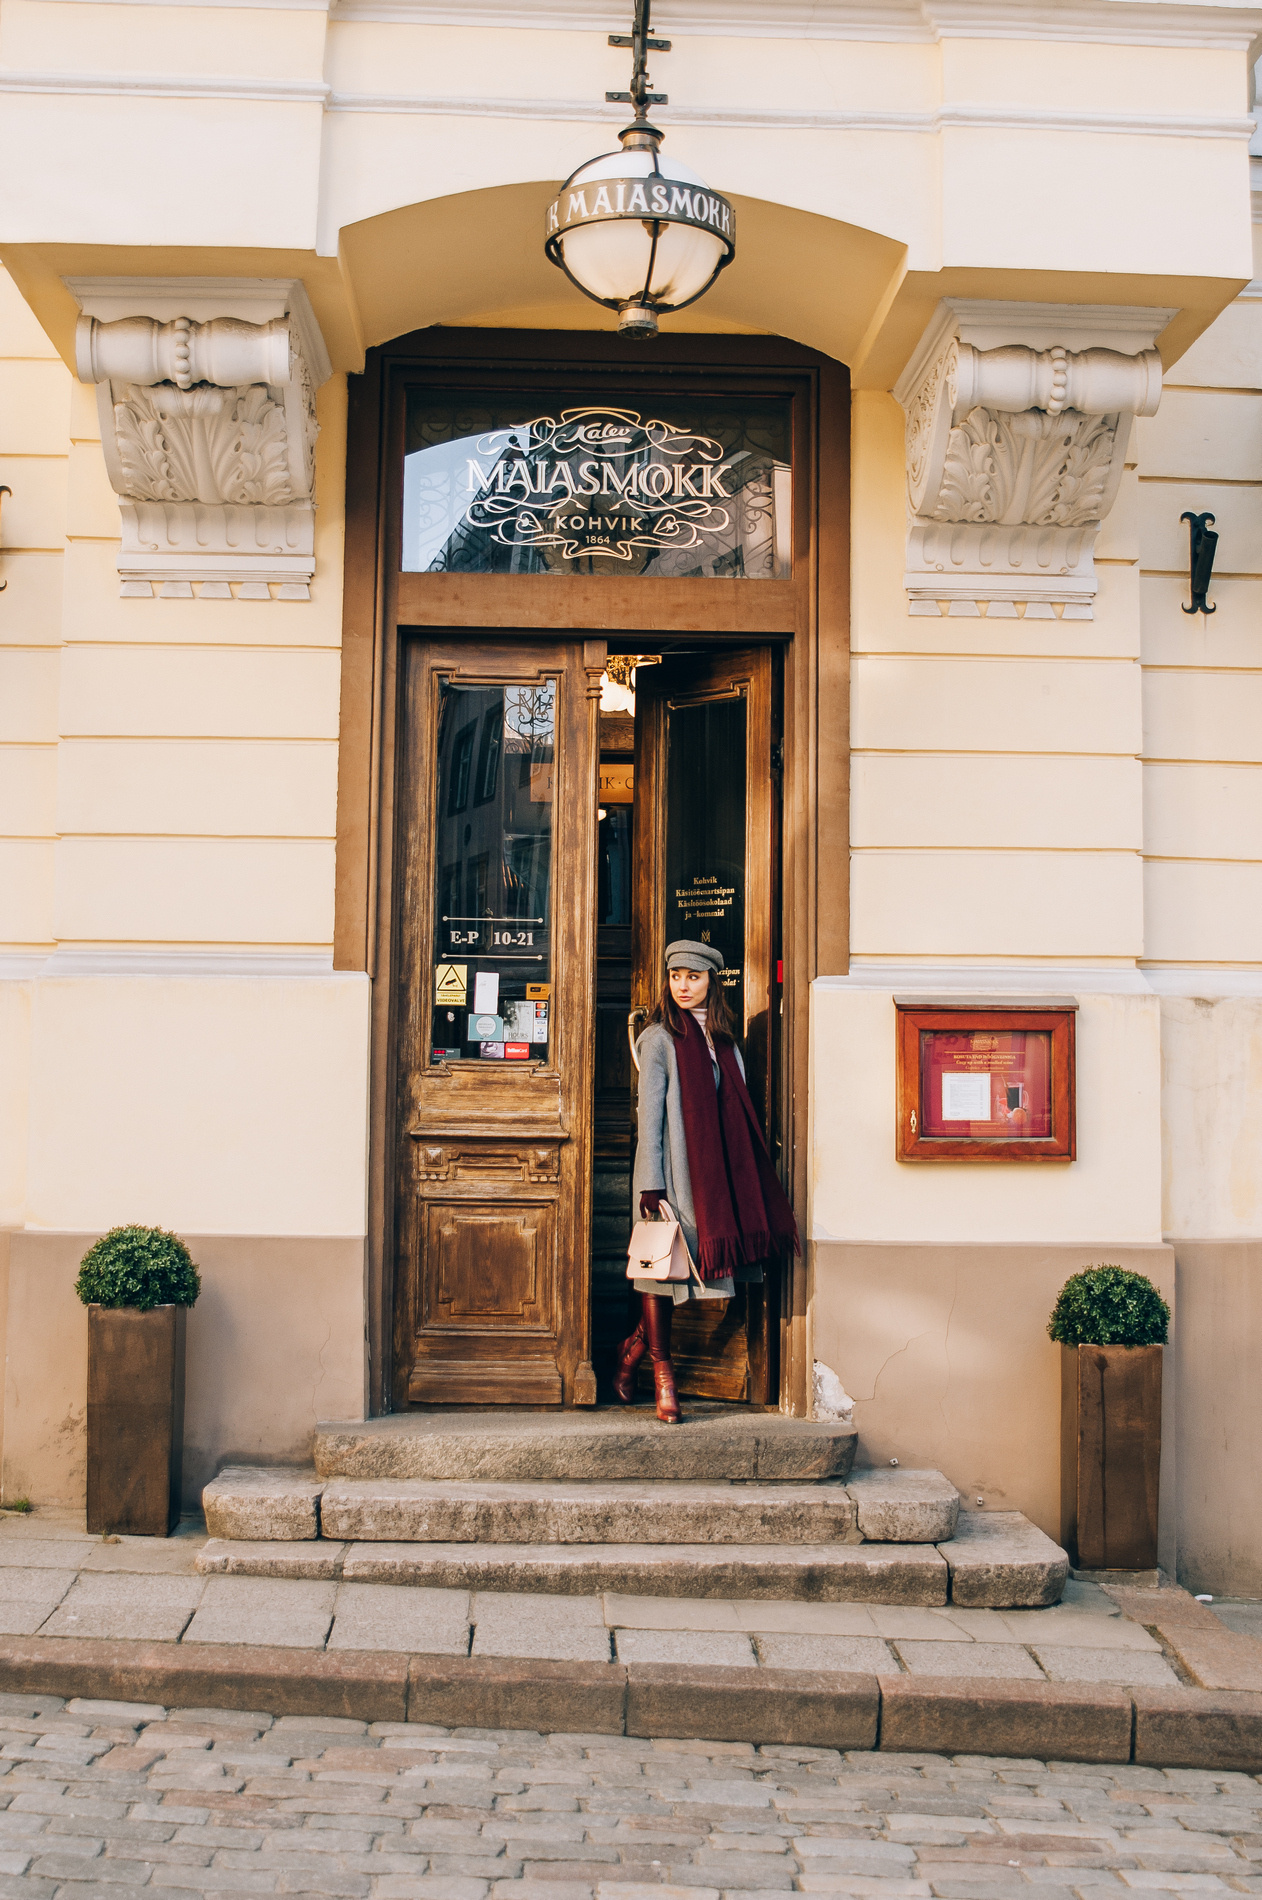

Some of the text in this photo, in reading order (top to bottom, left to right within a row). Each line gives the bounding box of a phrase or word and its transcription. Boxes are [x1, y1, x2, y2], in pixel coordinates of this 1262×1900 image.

[565, 183, 731, 236] MAIASMOKK
[563, 422, 631, 442] Kalev
[466, 459, 733, 499] MAIASMOKK
[555, 515, 646, 531] KOHVIK
[585, 535, 611, 545] 1864
[693, 876, 718, 885] Kohvik
[684, 911, 692, 920] ja
[450, 931, 534, 946] E-P 10-21
